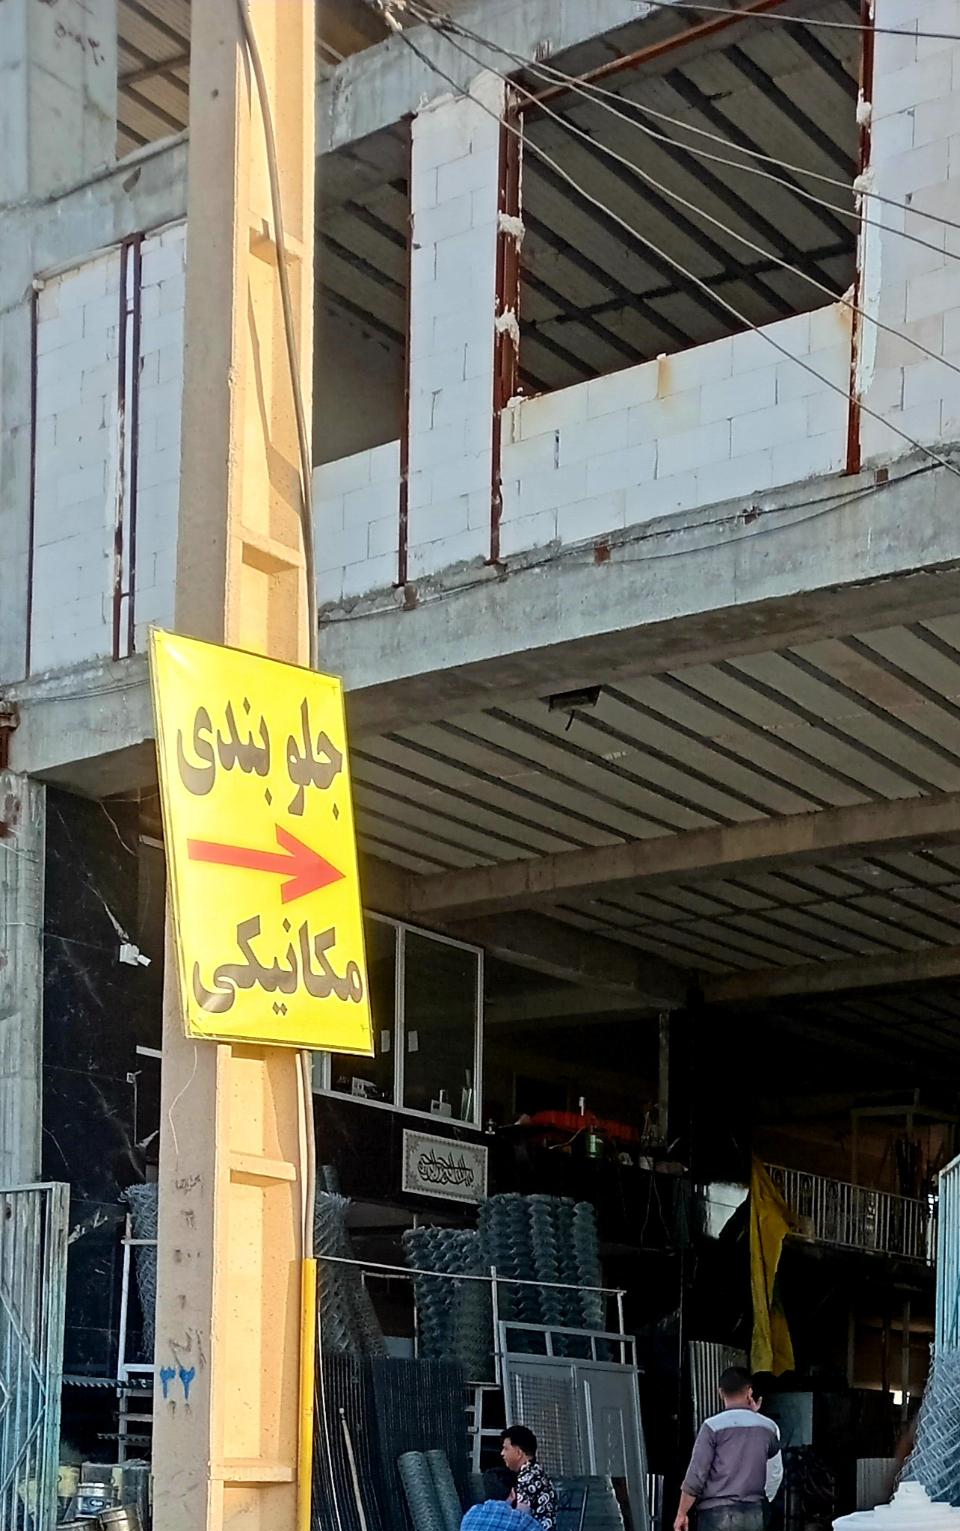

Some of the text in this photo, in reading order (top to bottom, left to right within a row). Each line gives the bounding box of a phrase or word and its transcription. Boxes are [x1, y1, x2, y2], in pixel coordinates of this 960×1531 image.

[177, 696, 343, 820] جلو بندی
[192, 914, 364, 1016] مکانیکی
